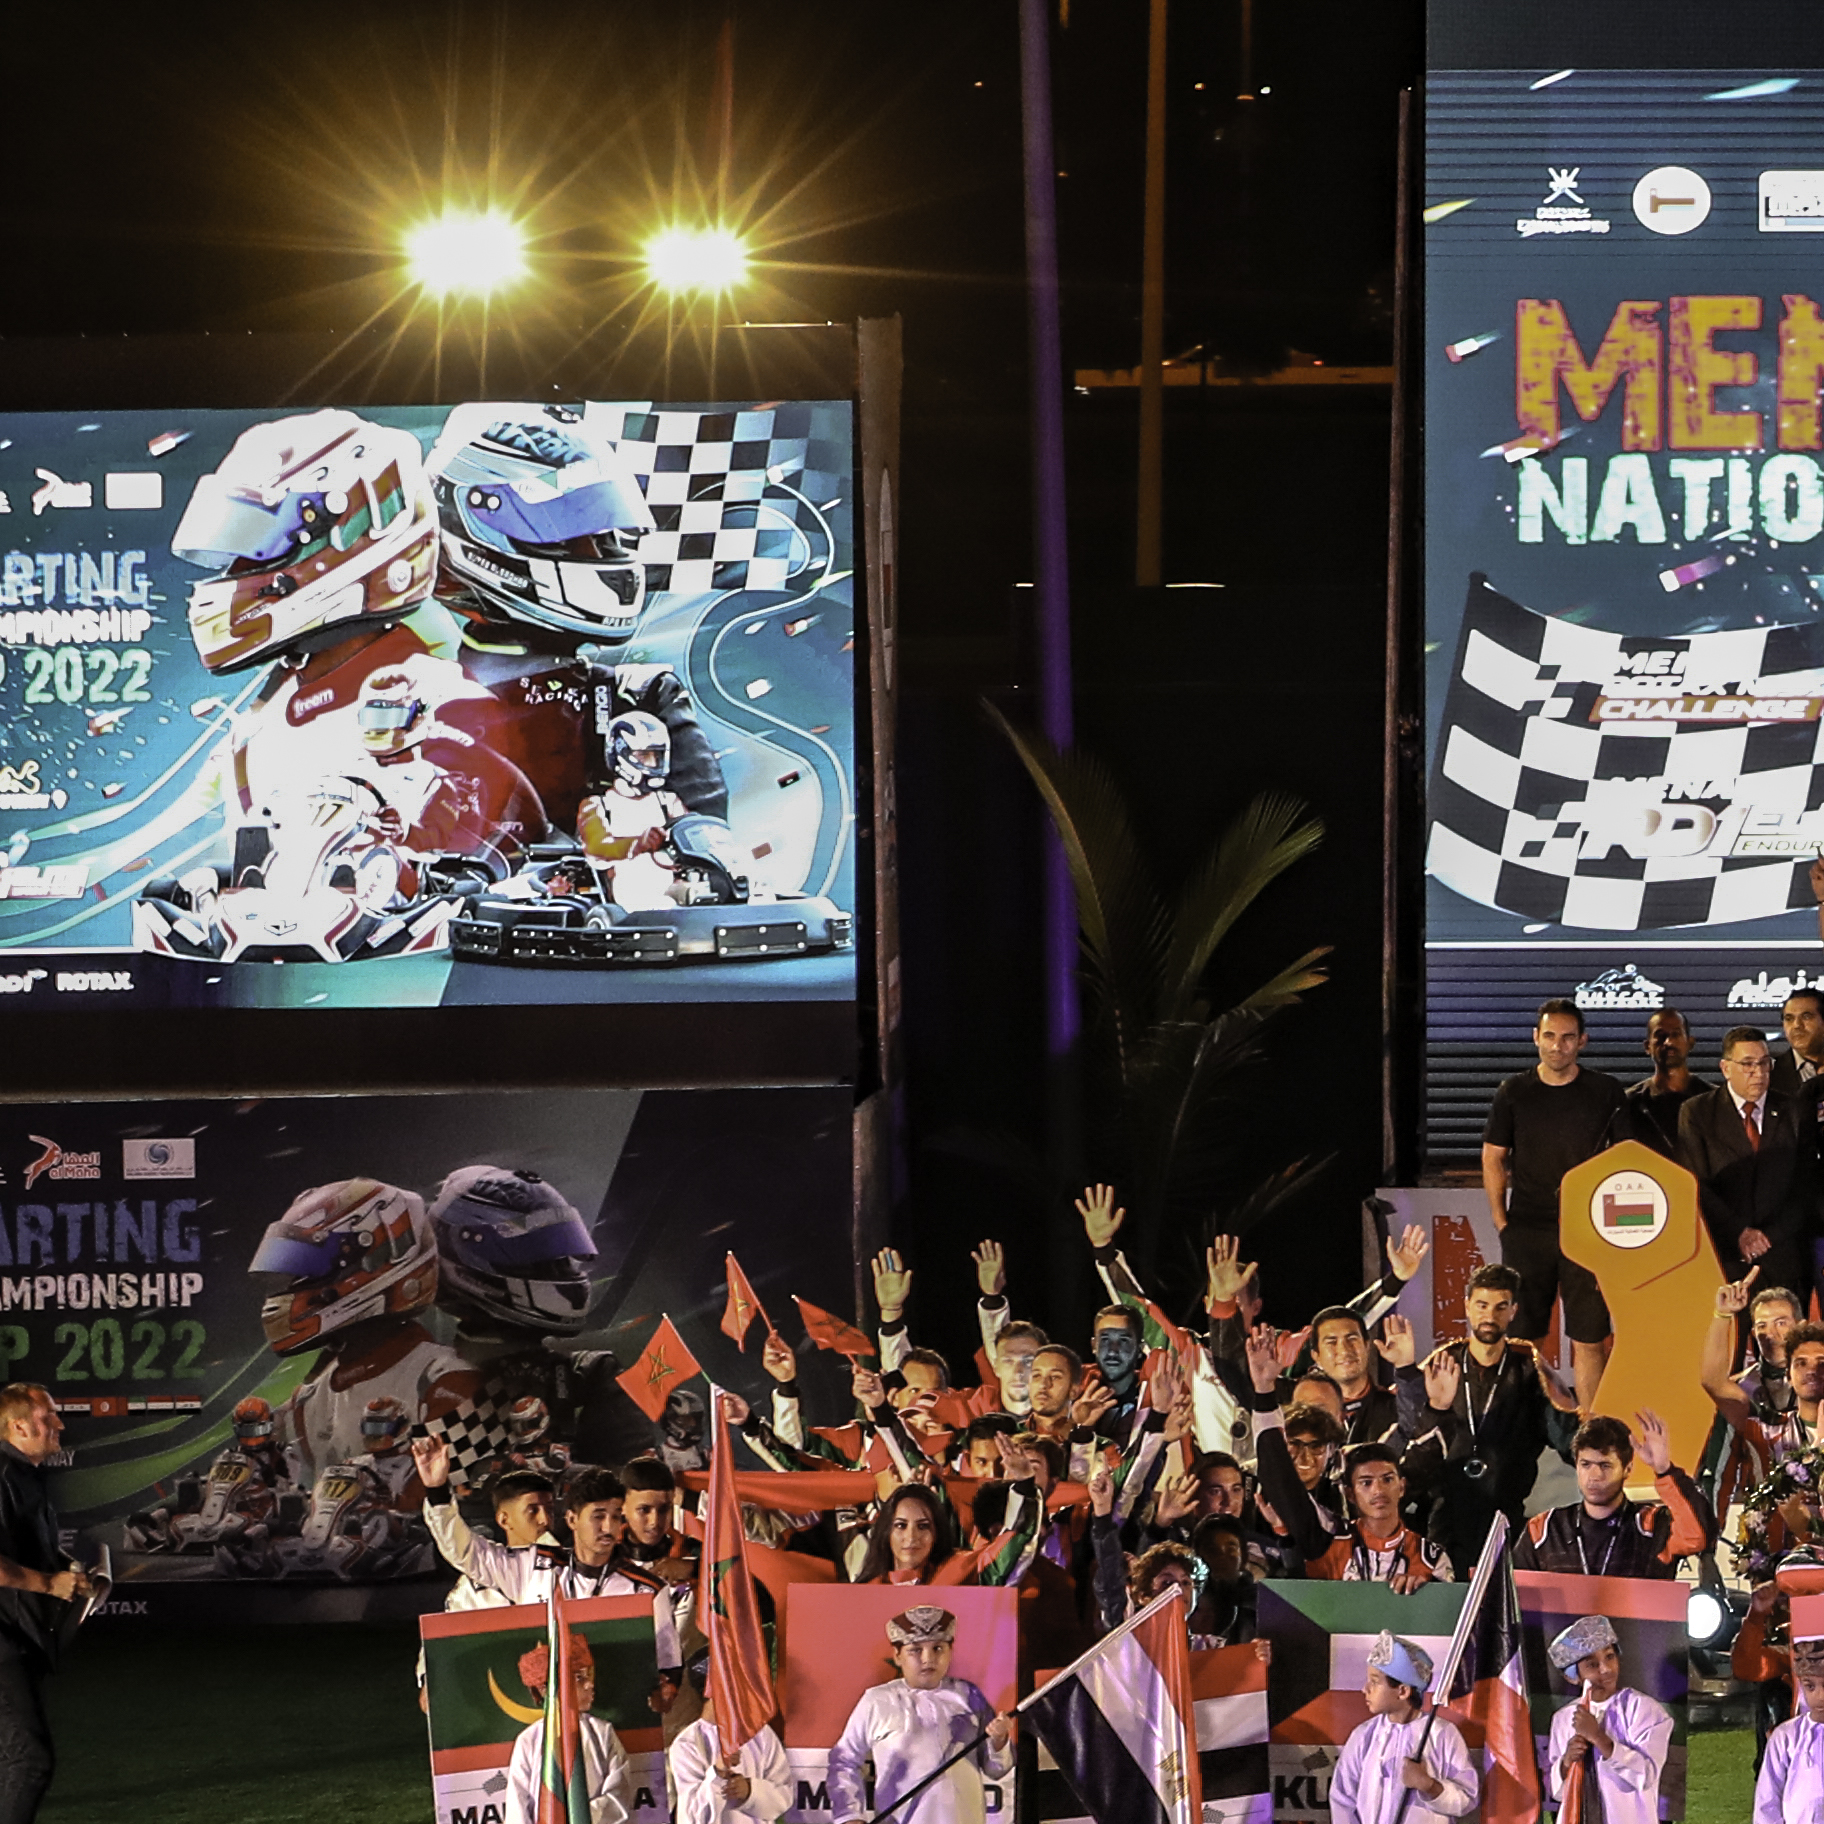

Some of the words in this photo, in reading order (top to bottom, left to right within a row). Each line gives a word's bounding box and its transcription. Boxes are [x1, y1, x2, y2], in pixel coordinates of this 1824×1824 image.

[2, 550, 149, 607] RTING
[24, 646, 152, 704] 2022
[1599, 698, 1812, 720] CHALLENGE
[50, 1167, 62, 1178] al
[63, 1167, 100, 1178] Maha
[54, 1317, 207, 1382] 2022
